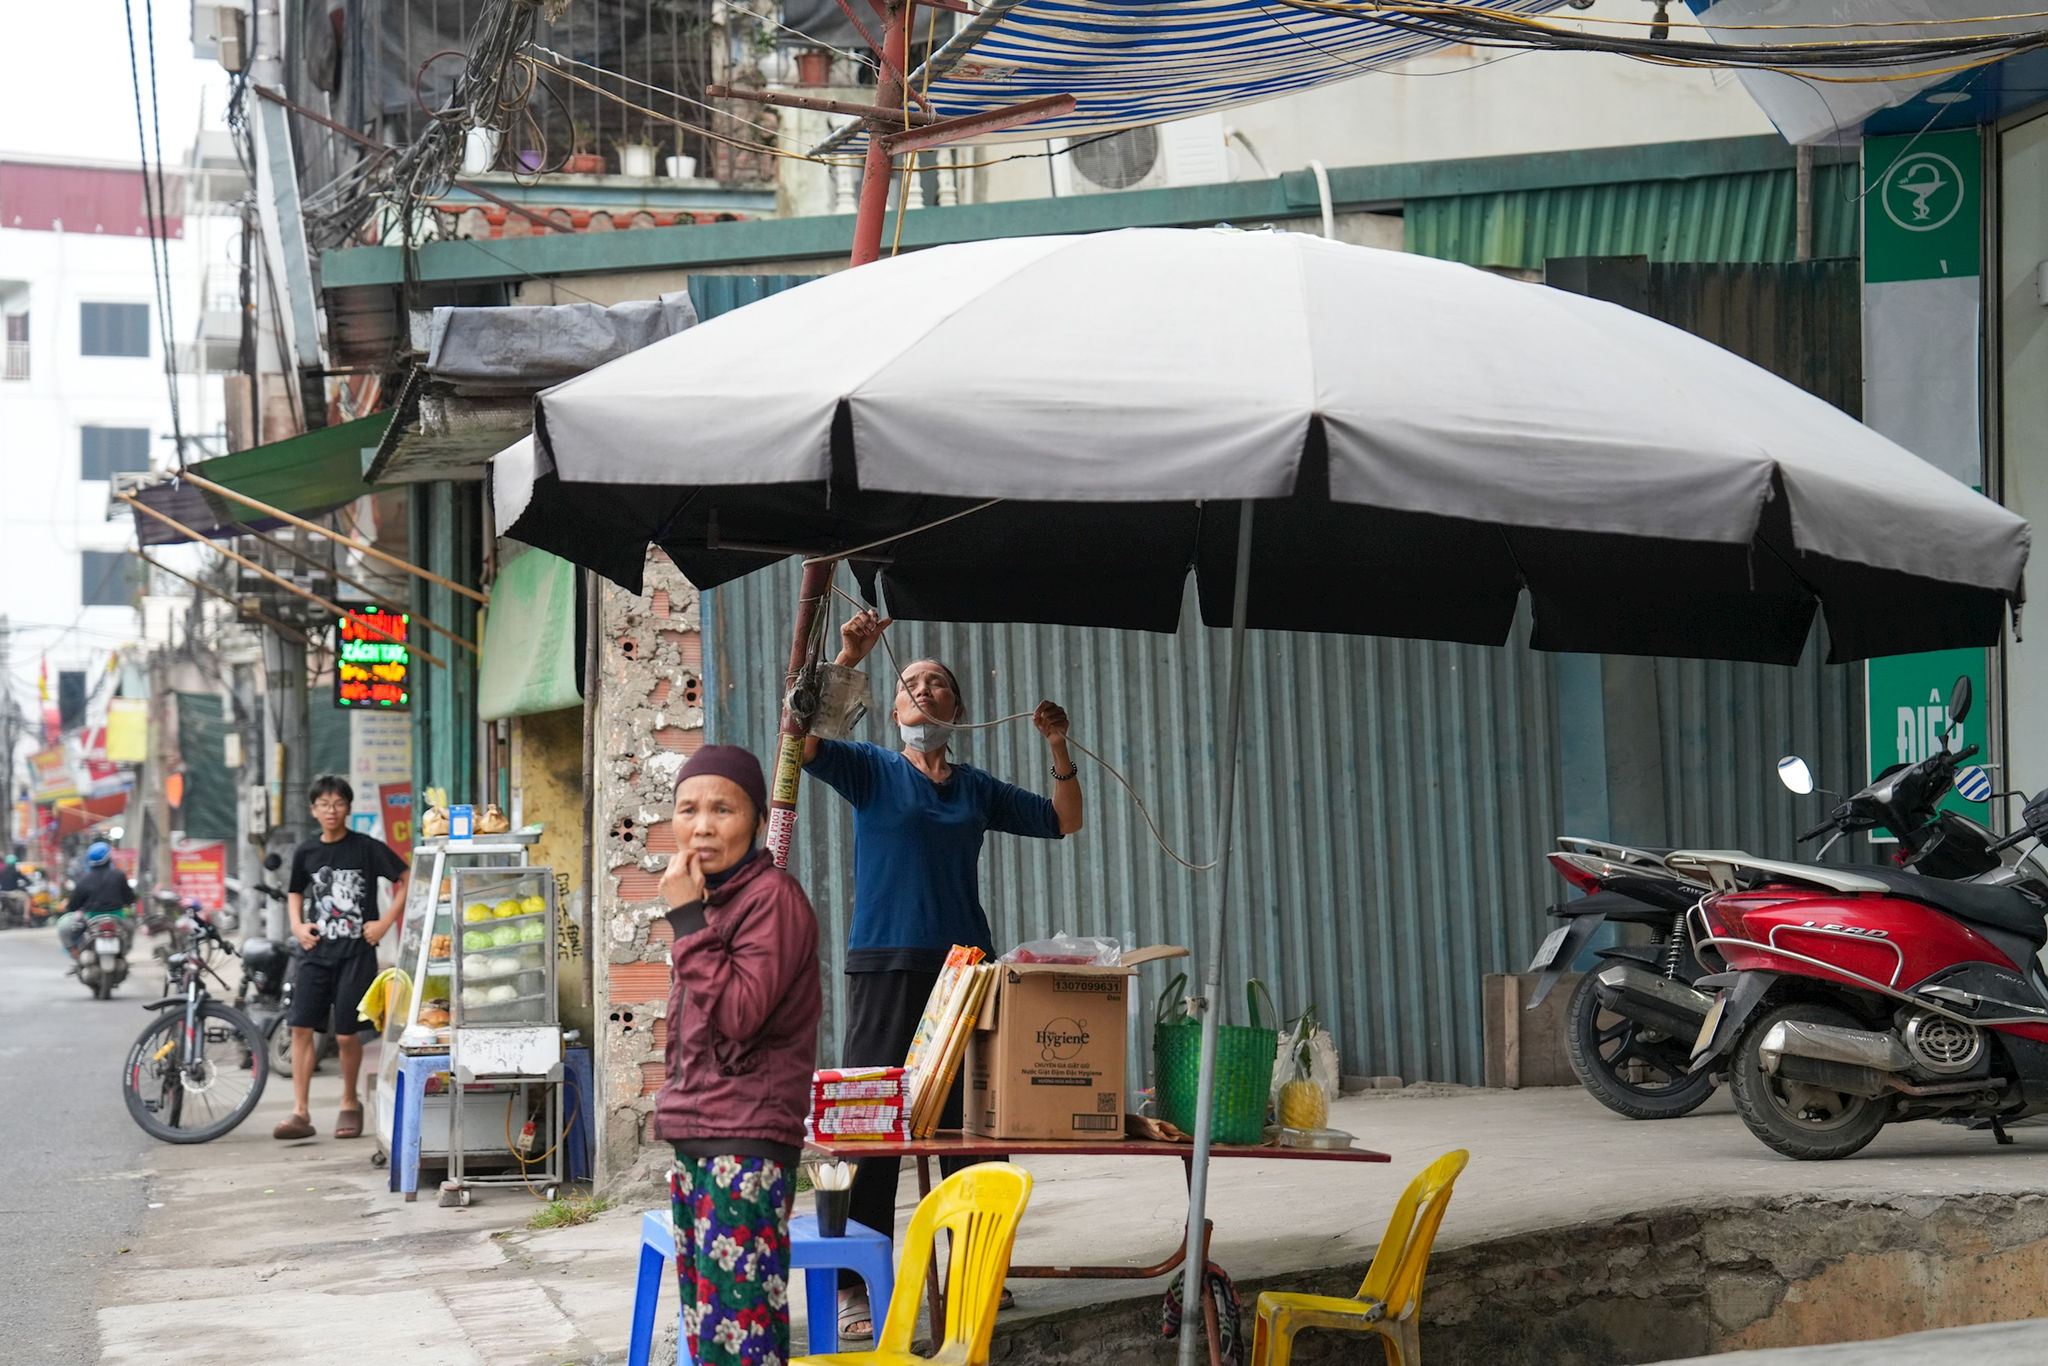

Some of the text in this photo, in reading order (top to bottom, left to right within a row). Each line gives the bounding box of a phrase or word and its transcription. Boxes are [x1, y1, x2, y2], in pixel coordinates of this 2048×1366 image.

[1801, 921, 1889, 938] LEAD
[1055, 981, 1119, 991] 1307099631
[1036, 1031, 1089, 1047] Hygiene
